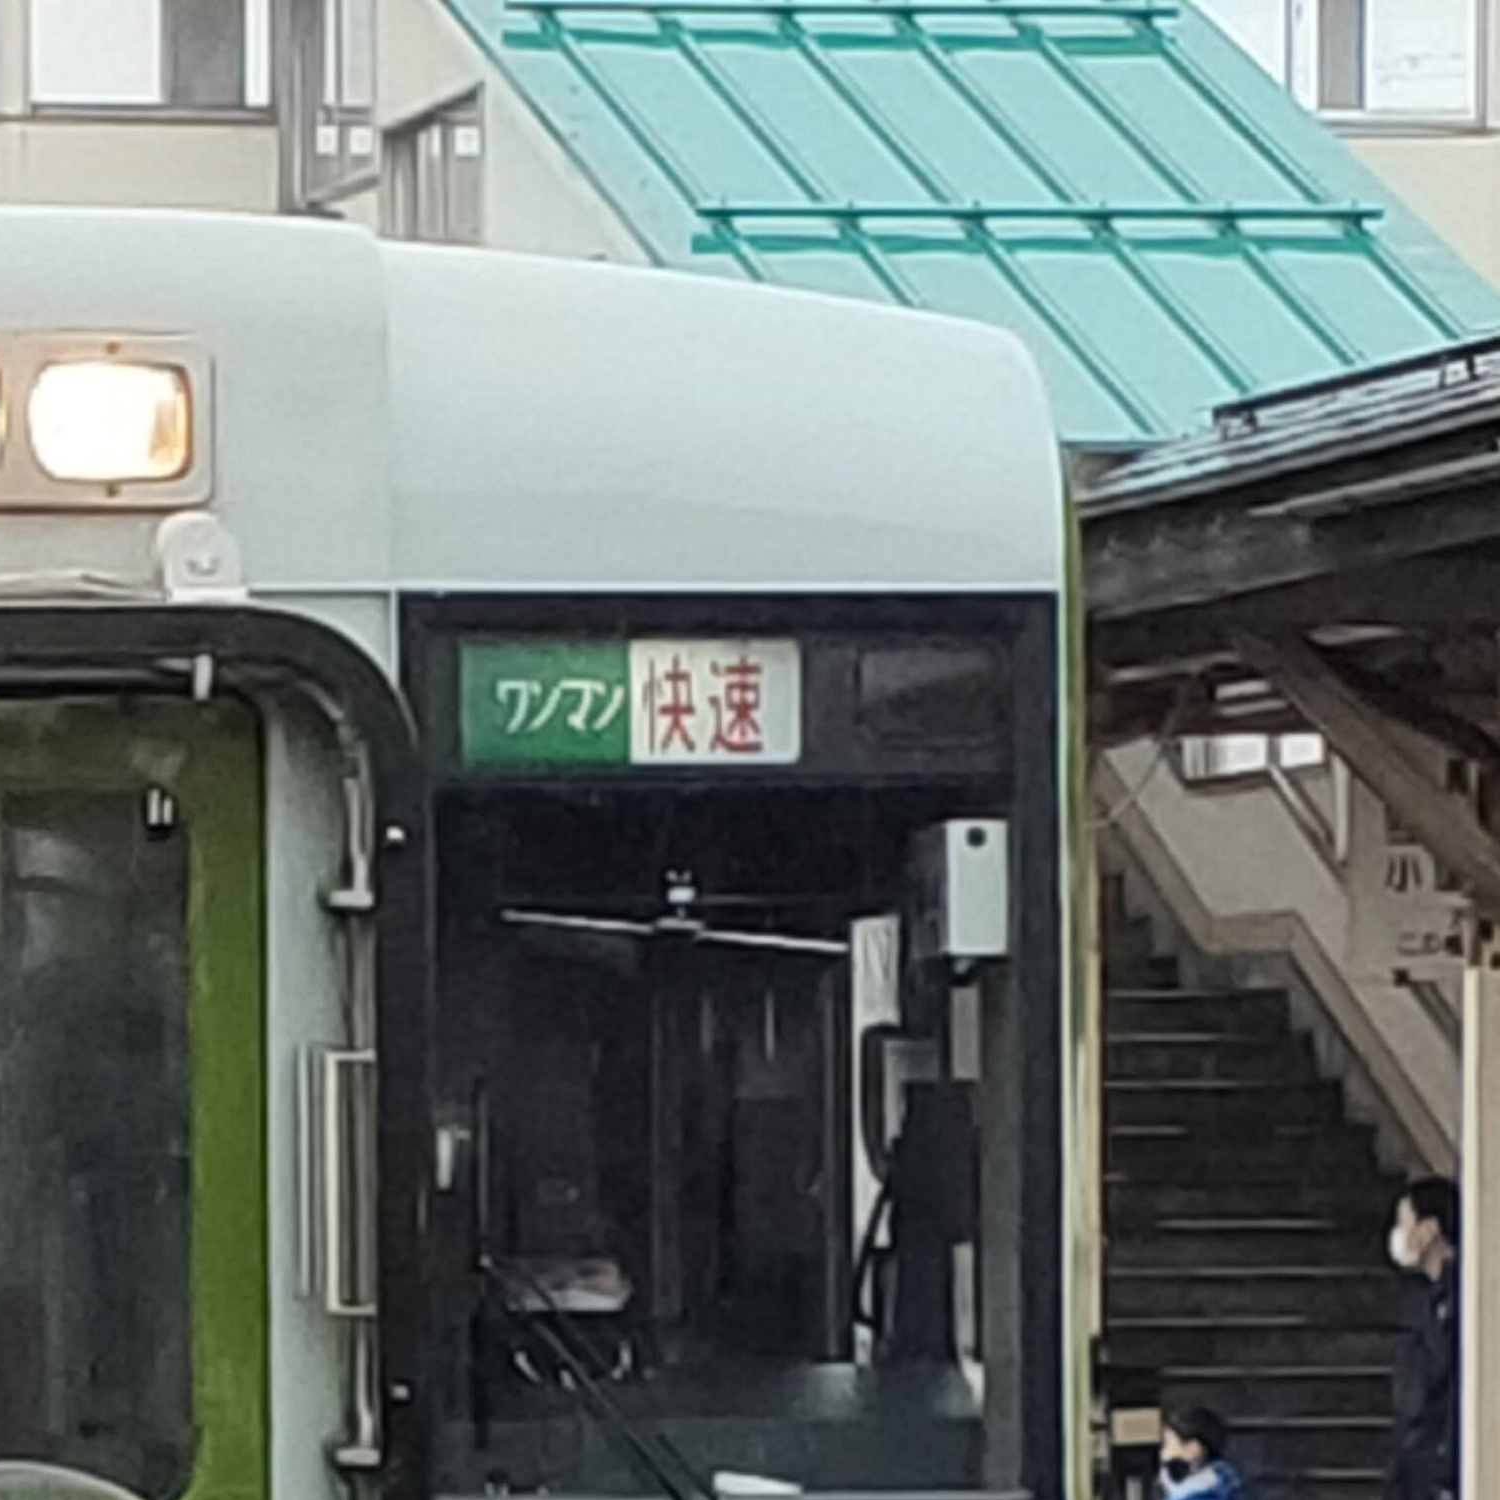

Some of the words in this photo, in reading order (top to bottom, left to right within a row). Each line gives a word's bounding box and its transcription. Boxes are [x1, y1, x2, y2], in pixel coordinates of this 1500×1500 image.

[496, 677, 626, 734] ワンマン
[642, 653, 764, 753] 快速
